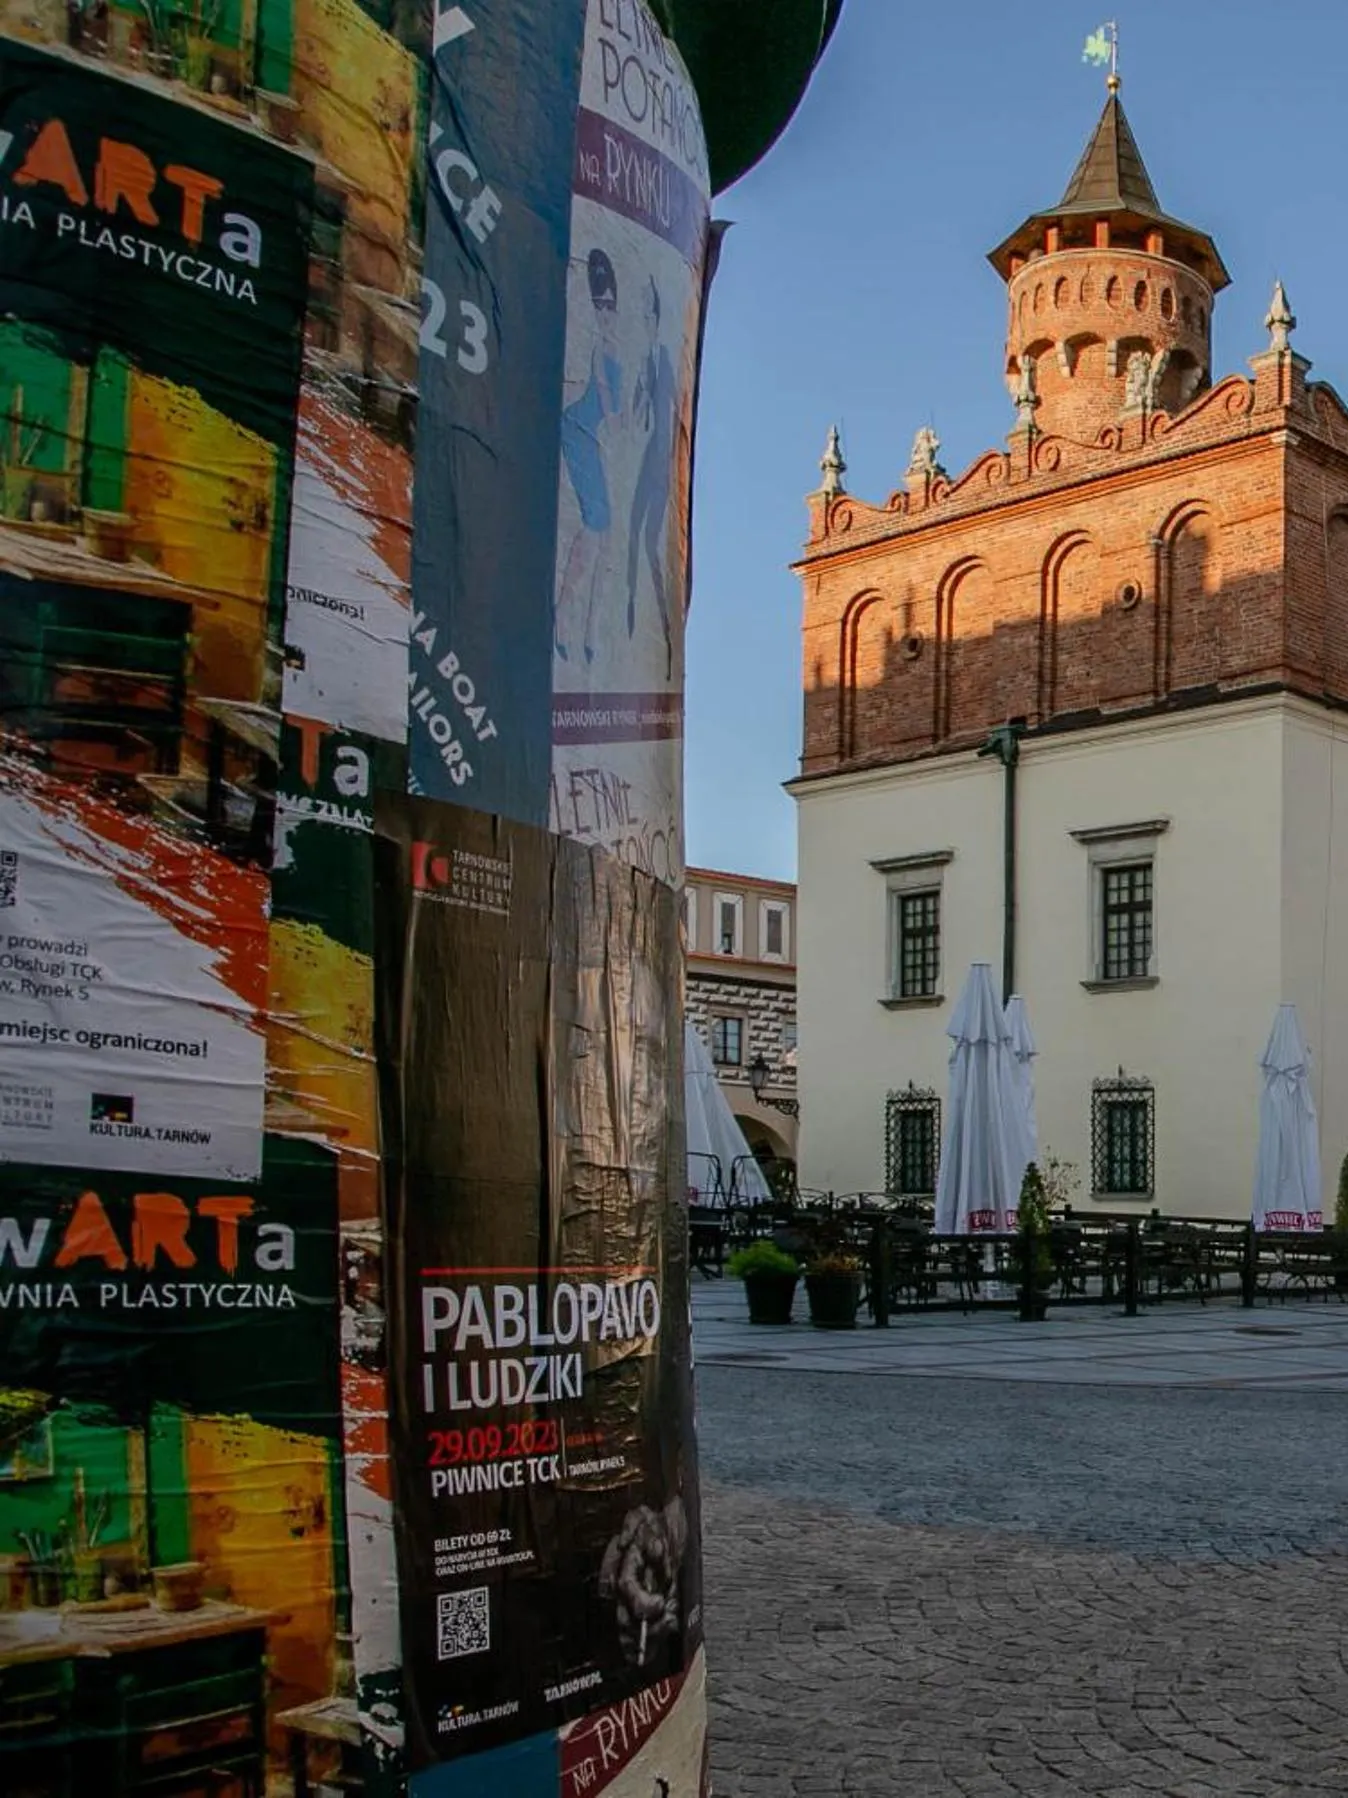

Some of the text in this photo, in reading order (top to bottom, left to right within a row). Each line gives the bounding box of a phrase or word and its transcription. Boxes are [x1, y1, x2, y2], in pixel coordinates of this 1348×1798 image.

[0, 118, 262, 268] ARTa
[580, 133, 670, 228] NA RYNKU
[57, 212, 257, 304] PLASTYCZNA
[437, 650, 498, 742] BOAT
[8, 934, 89, 957] prowadzi
[21, 978, 74, 999] Rynek
[0, 1020, 208, 1058] miejsc ograniczona!
[101, 1283, 296, 1308] PLASTYCZNA
[421, 1280, 661, 1353] PABLOPAVO
[423, 1352, 583, 1413] I LUDZIKI
[431, 1454, 562, 1498] PIWNICE TCK
[434, 1535, 468, 1553] BILETY
